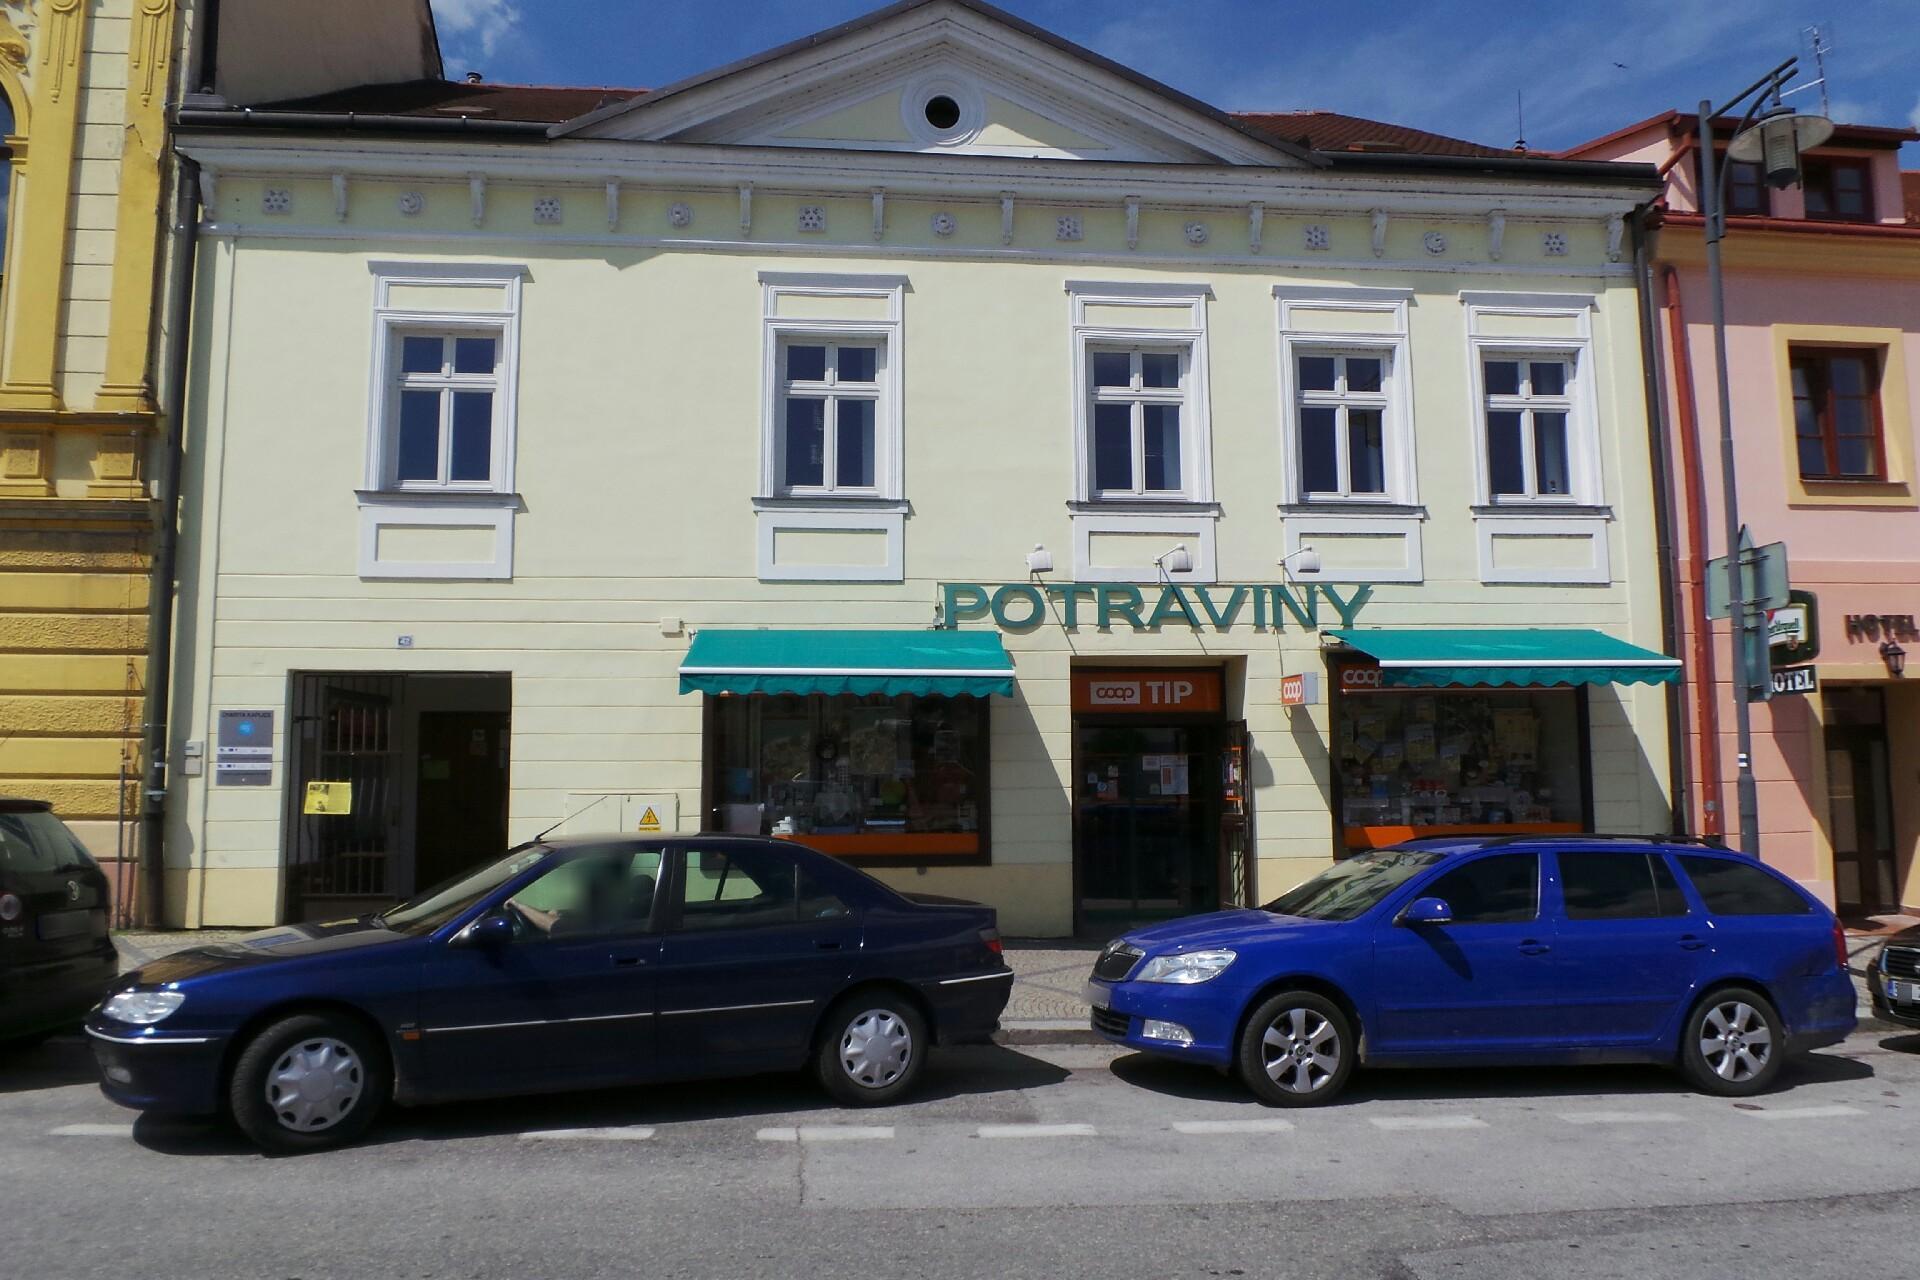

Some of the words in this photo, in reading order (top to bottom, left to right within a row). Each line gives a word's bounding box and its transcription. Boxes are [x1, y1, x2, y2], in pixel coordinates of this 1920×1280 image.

[943, 583, 1374, 629] POTRAVINY
[1844, 614, 1919, 644] HOTEL
[1146, 681, 1193, 704] TIP
[1771, 670, 1814, 692] OTEL
